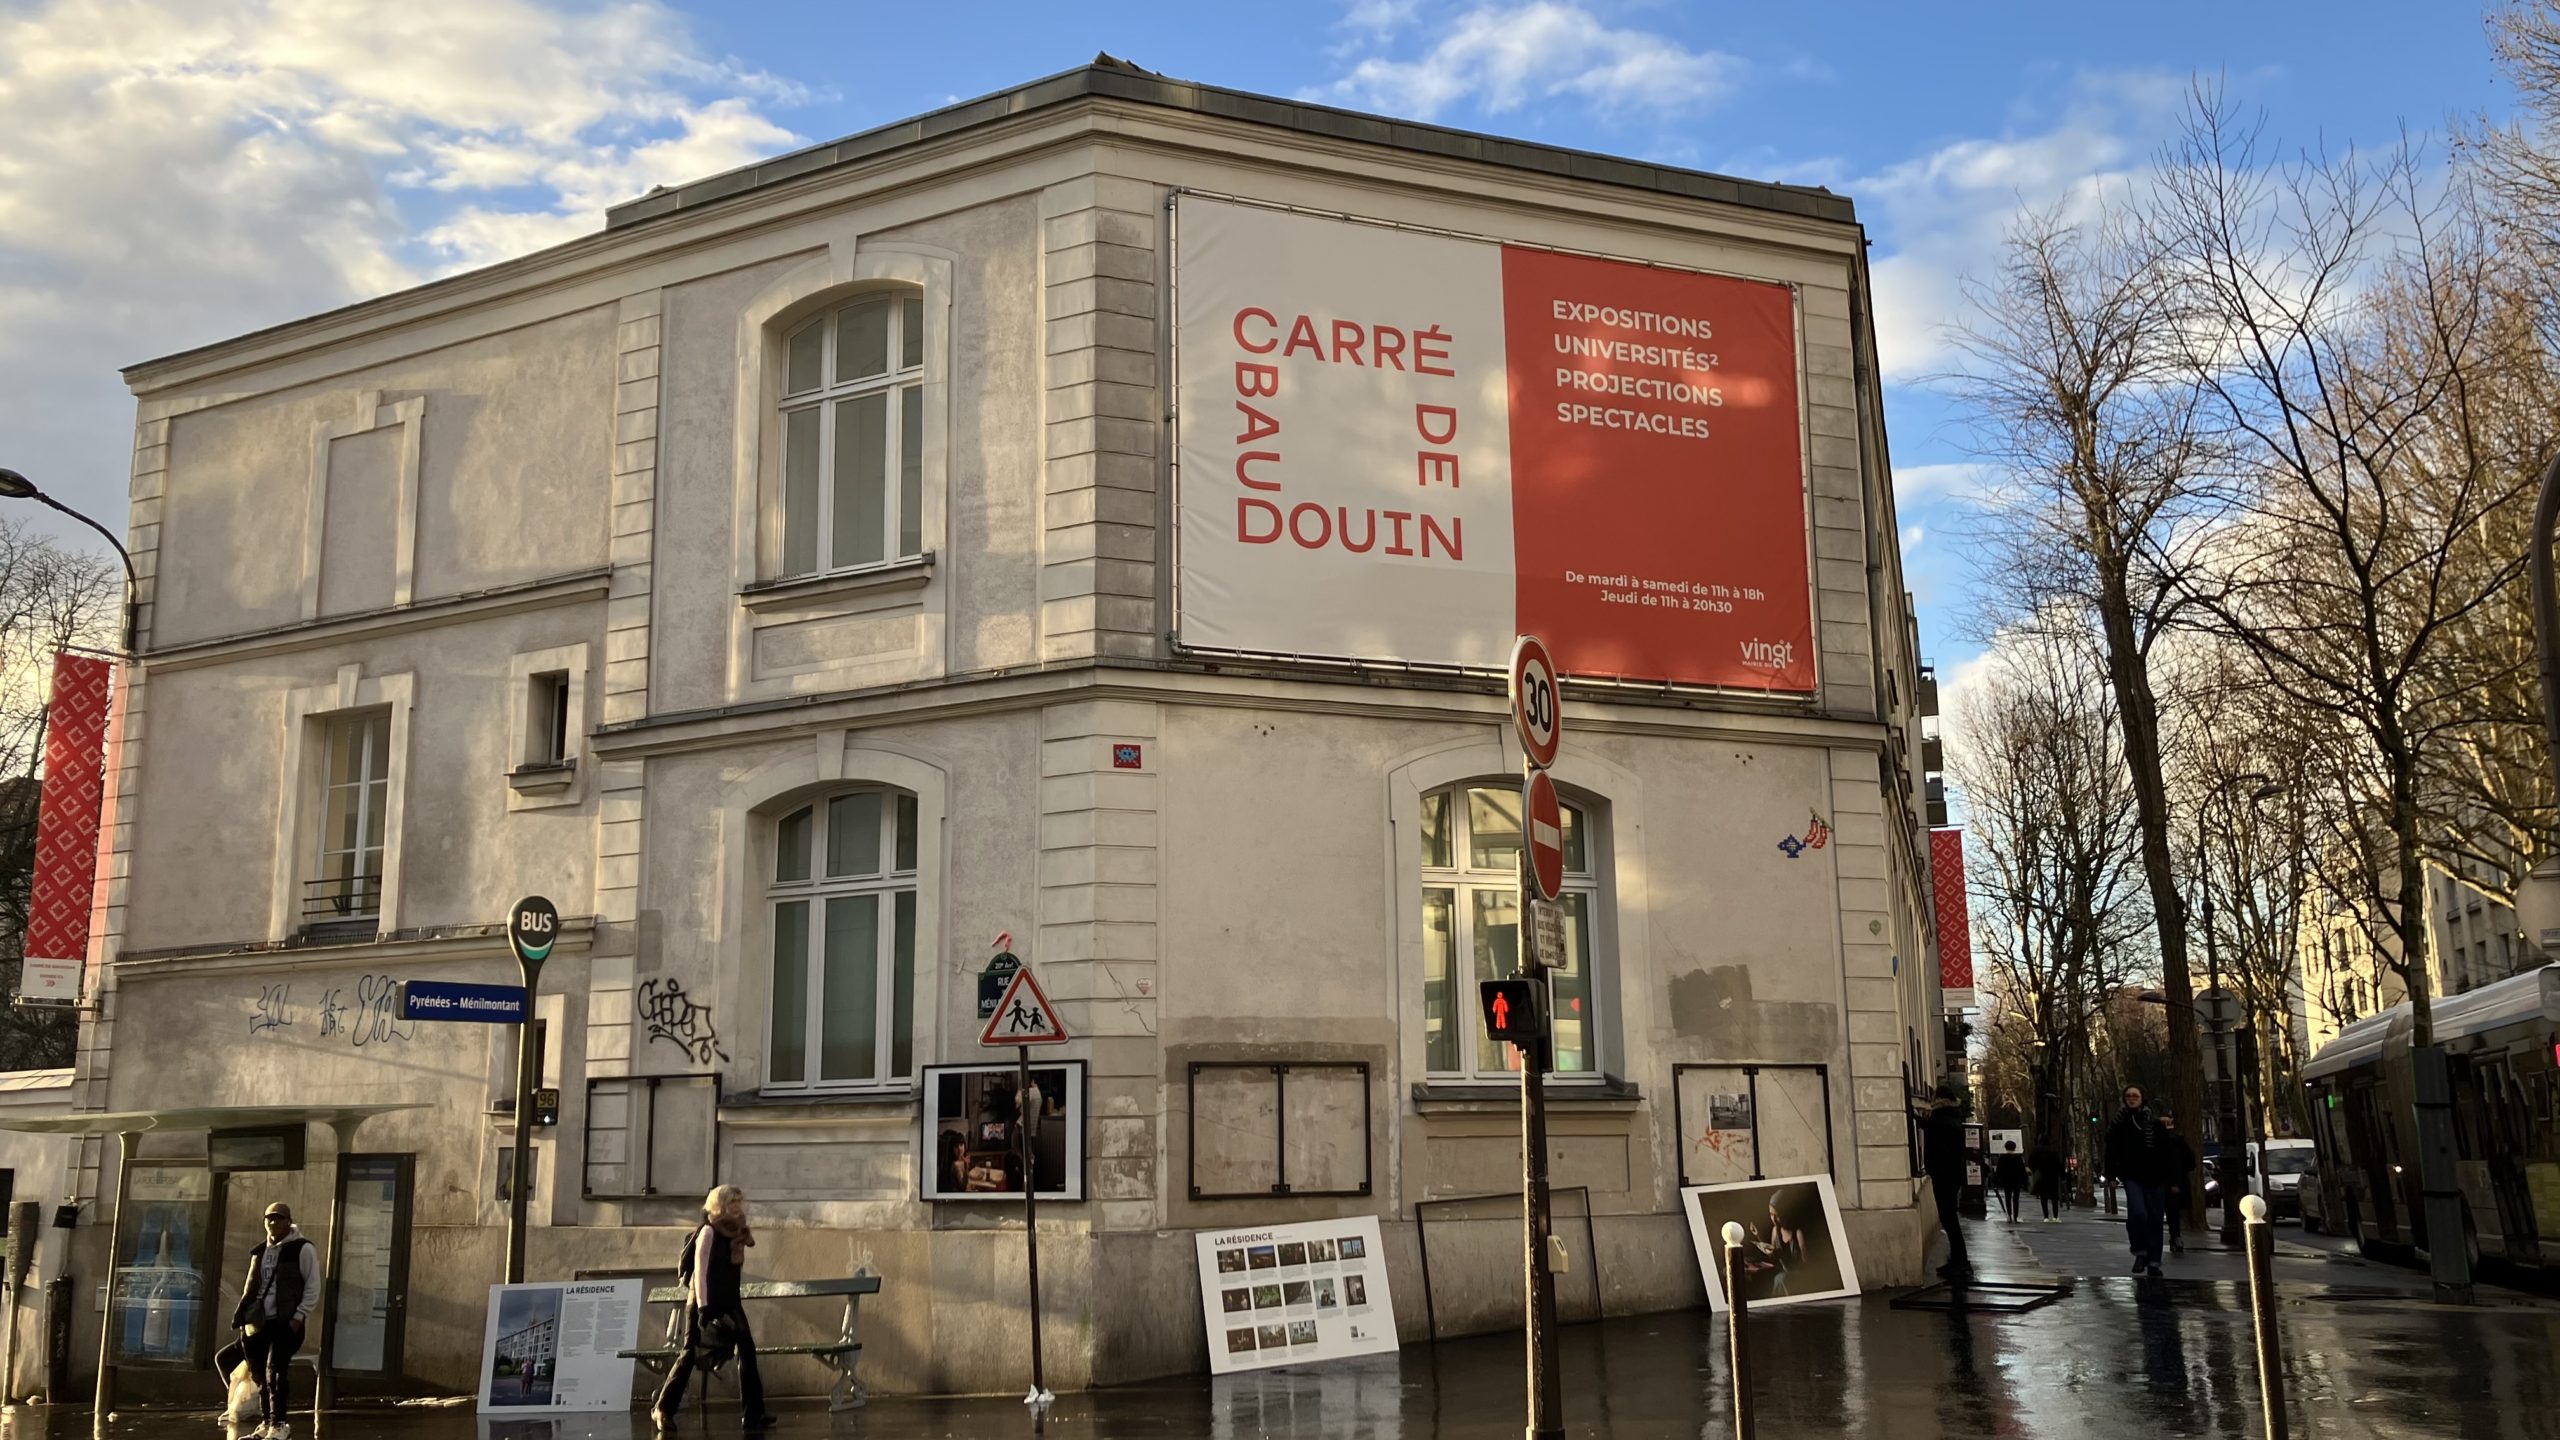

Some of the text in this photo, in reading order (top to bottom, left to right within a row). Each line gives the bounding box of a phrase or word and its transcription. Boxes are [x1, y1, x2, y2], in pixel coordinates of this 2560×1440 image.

[1552, 299, 1713, 340] EXPOSITIONS
[1234, 306, 1456, 376] CARRÉ
[1556, 367, 1723, 407] PROJECTIONS
[1557, 402, 1710, 438] SPECTACLES
[1416, 404, 1460, 487] DE
[1565, 570, 1765, 601] De mardi à samedi de 11h à 18h
[1600, 589, 1733, 614] Jeudi de 11h à 20h30
[1524, 671, 1552, 733] 30
[521, 911, 552, 932] BUS
[997, 977, 1010, 986] RUE
[409, 994, 451, 1010] Pyrénées
[459, 996, 520, 1011] Ménilmontant
[539, 1092, 555, 1106] 96
[1214, 1232, 1274, 1246] LA RÉSIDENCE
[575, 1284, 616, 1294] RÉSIDENCE
